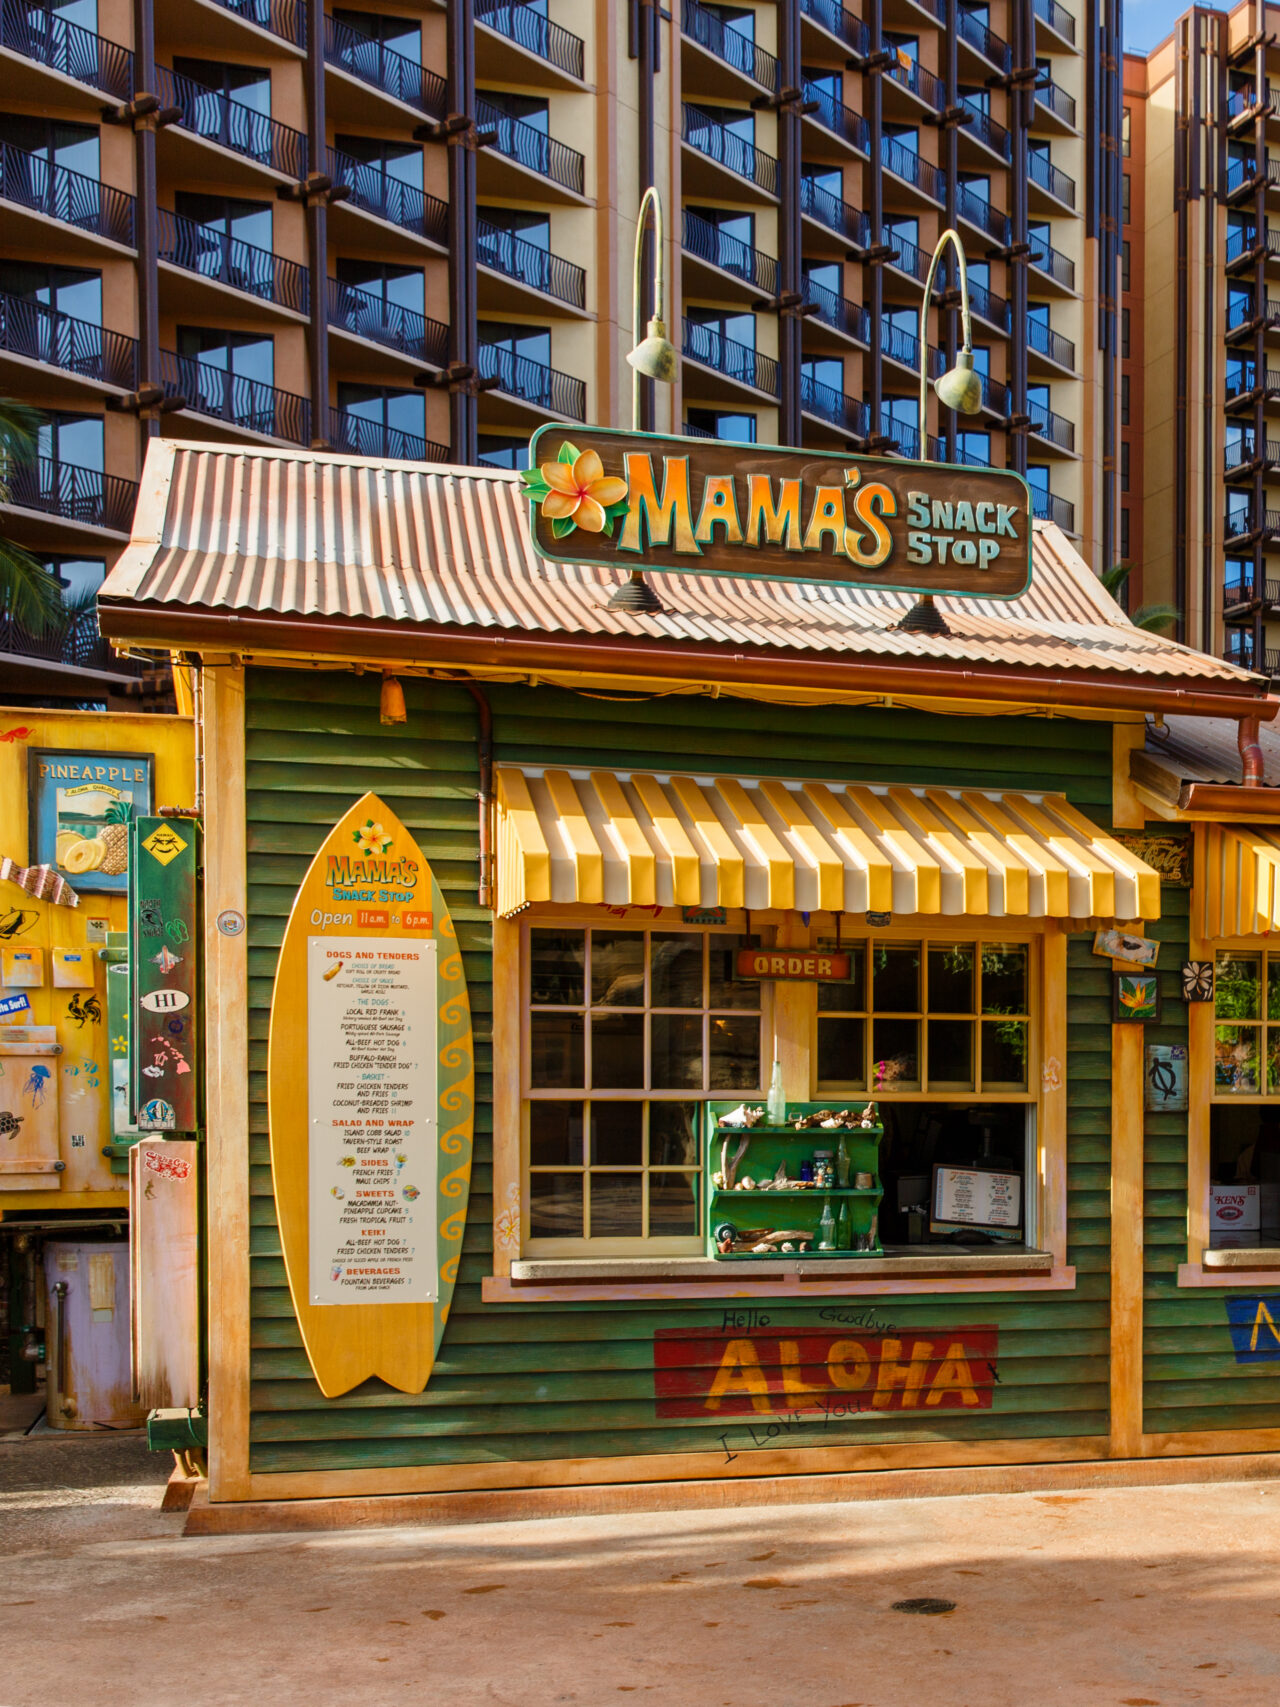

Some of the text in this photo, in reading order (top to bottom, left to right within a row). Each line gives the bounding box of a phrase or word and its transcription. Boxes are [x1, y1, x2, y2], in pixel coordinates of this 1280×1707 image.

[616, 450, 898, 570] MAMA'S
[906, 491, 1019, 539] SNACK
[906, 531, 1000, 570] STOP
[38, 764, 145, 782] PINEAPPLE
[325, 855, 419, 888] MAMA'S
[332, 887, 414, 903] SNACK STOP
[310, 908, 353, 930] Open
[391, 915, 401, 924] to
[406, 913, 412, 924] 6
[326, 951, 352, 959] DOGS
[377, 952, 420, 961] TENDERS
[753, 957, 832, 976] ORDER
[154, 992, 177, 1008] HI
[371, 998, 389, 1006] DOGS
[379, 1024, 405, 1032] SAUSAGE
[349, 1054, 397, 1062] BUFFALO-RANCH
[372, 1090, 389, 1098] FRIES
[332, 1099, 389, 1107] COCONUT-BREADED
[332, 1119, 414, 1127] SALAD AND WRAP
[355, 1190, 394, 1198] SWEETS
[722, 1309, 771, 1334] Hello
[703, 1338, 980, 1415] ALOHA
[719, 1432, 738, 1464] I
[747, 1409, 808, 1446] LOVE
